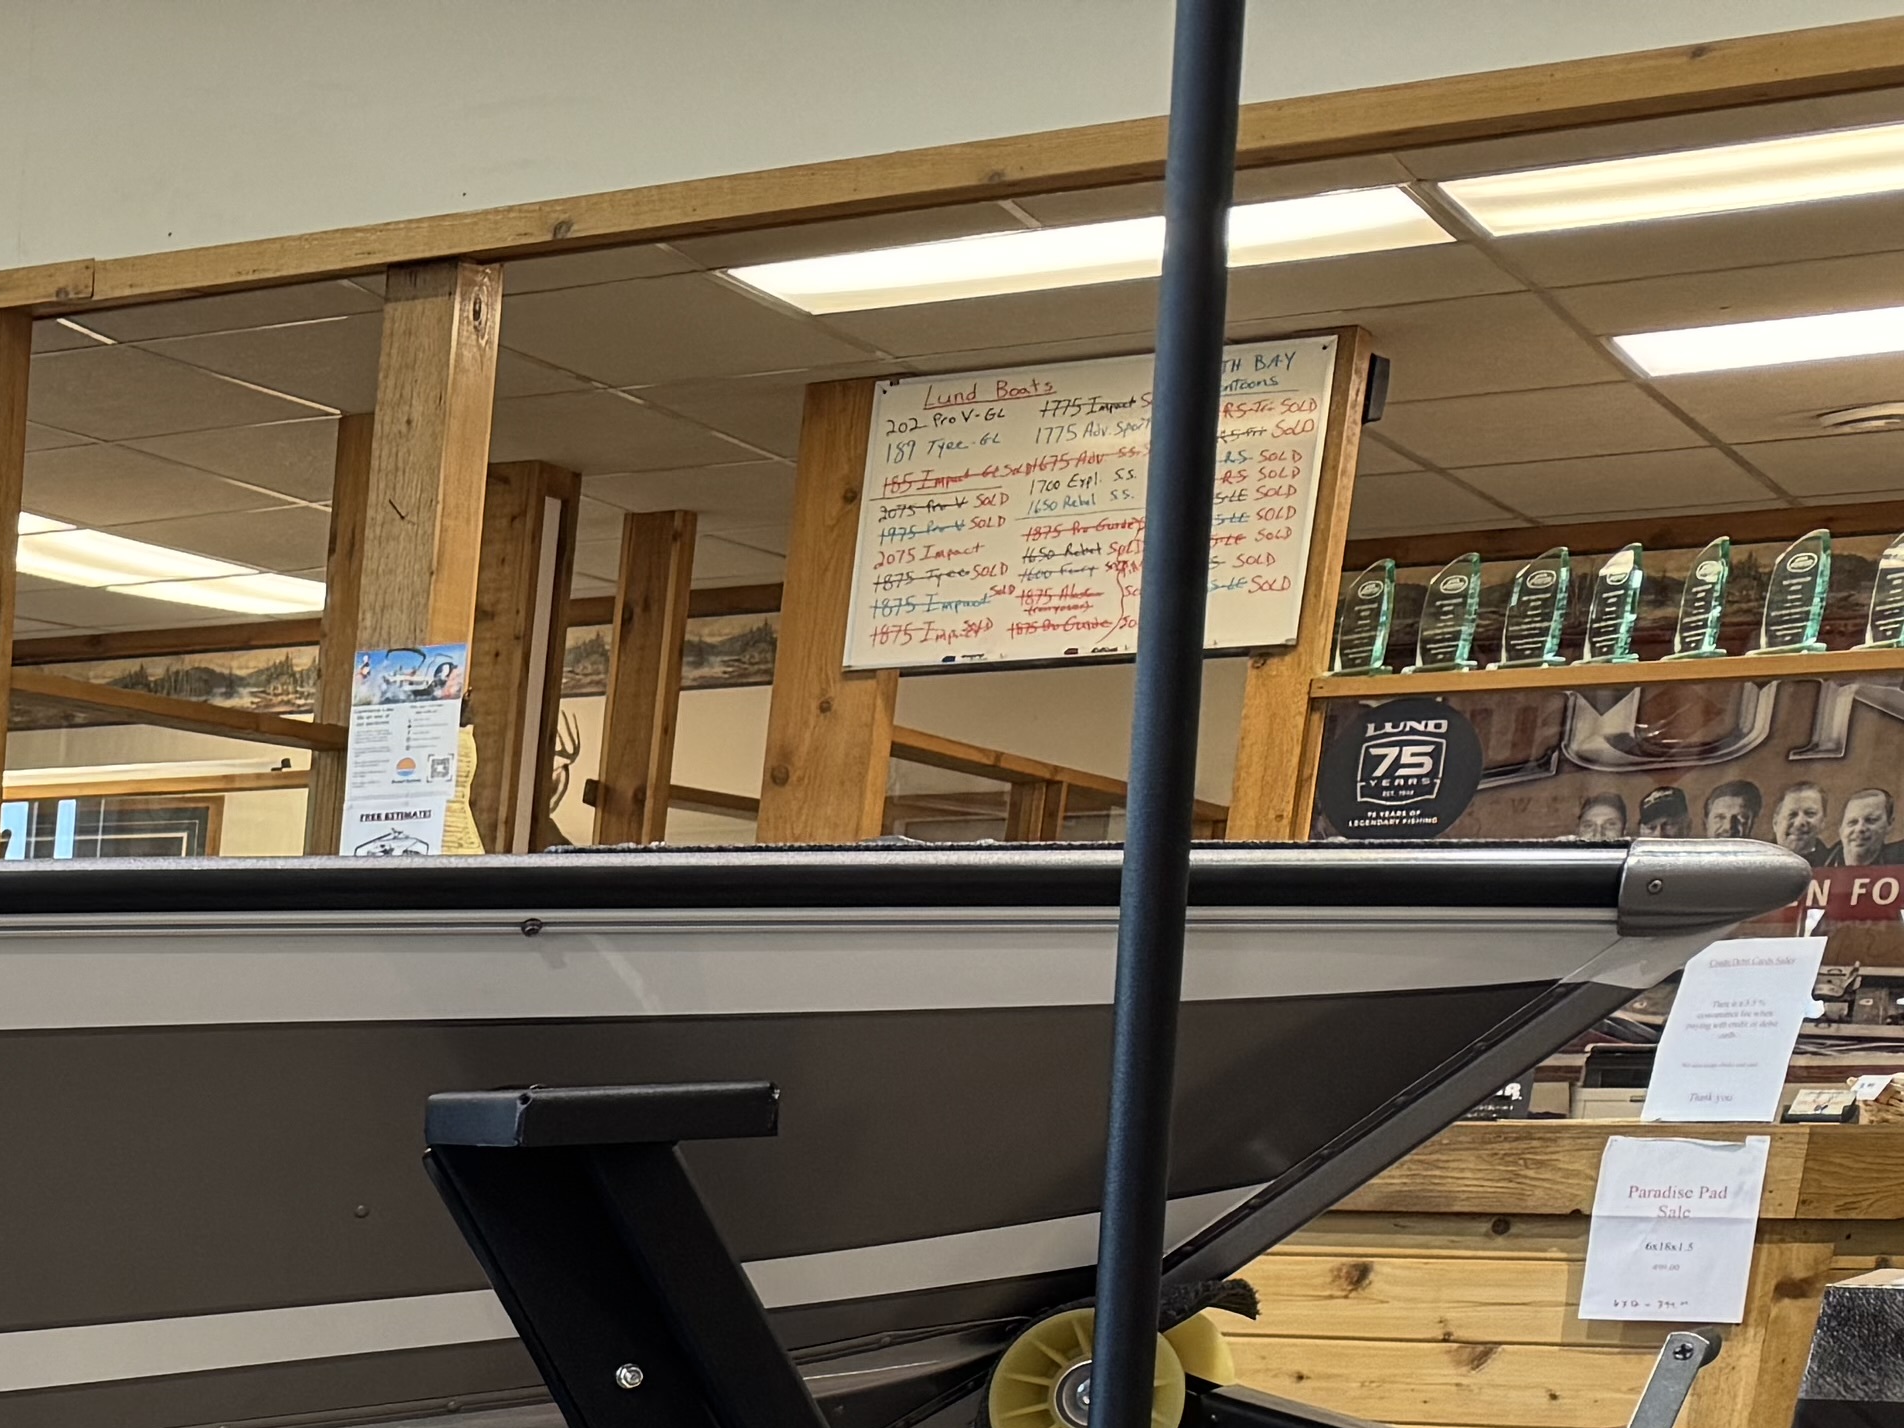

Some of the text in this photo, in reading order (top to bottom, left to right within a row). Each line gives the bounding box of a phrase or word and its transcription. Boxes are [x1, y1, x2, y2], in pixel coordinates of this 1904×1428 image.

[1254, 351, 1296, 372] BAY
[923, 380, 1054, 407] Lund Boats
[1280, 398, 1318, 415] SOLD
[886, 418, 928, 436] 202
[1035, 424, 1078, 444] 1775
[886, 439, 916, 463] 189
[1258, 449, 1302, 463] SOLD
[1257, 466, 1300, 481] SOLD
[1254, 484, 1297, 500] SOLD
[1256, 505, 1297, 521] SOLD
[968, 515, 1007, 530] SOLD
[1255, 526, 1293, 542] SOLD
[873, 542, 986, 570] 2075 Impact
[1232, 552, 1276, 568] SOLD
[970, 562, 1009, 580] SOLD
[1248, 575, 1291, 593] SOLD
[1365, 720, 1448, 737] LUND
[1369, 745, 1436, 777] 75
[1369, 778, 1431, 787] YEARS
[360, 812, 382, 822] FREE
[1850, 877, 1900, 907] FO
[1628, 1185, 1729, 1200] Paradise Pad
[1657, 1204, 1691, 1219] Sale
